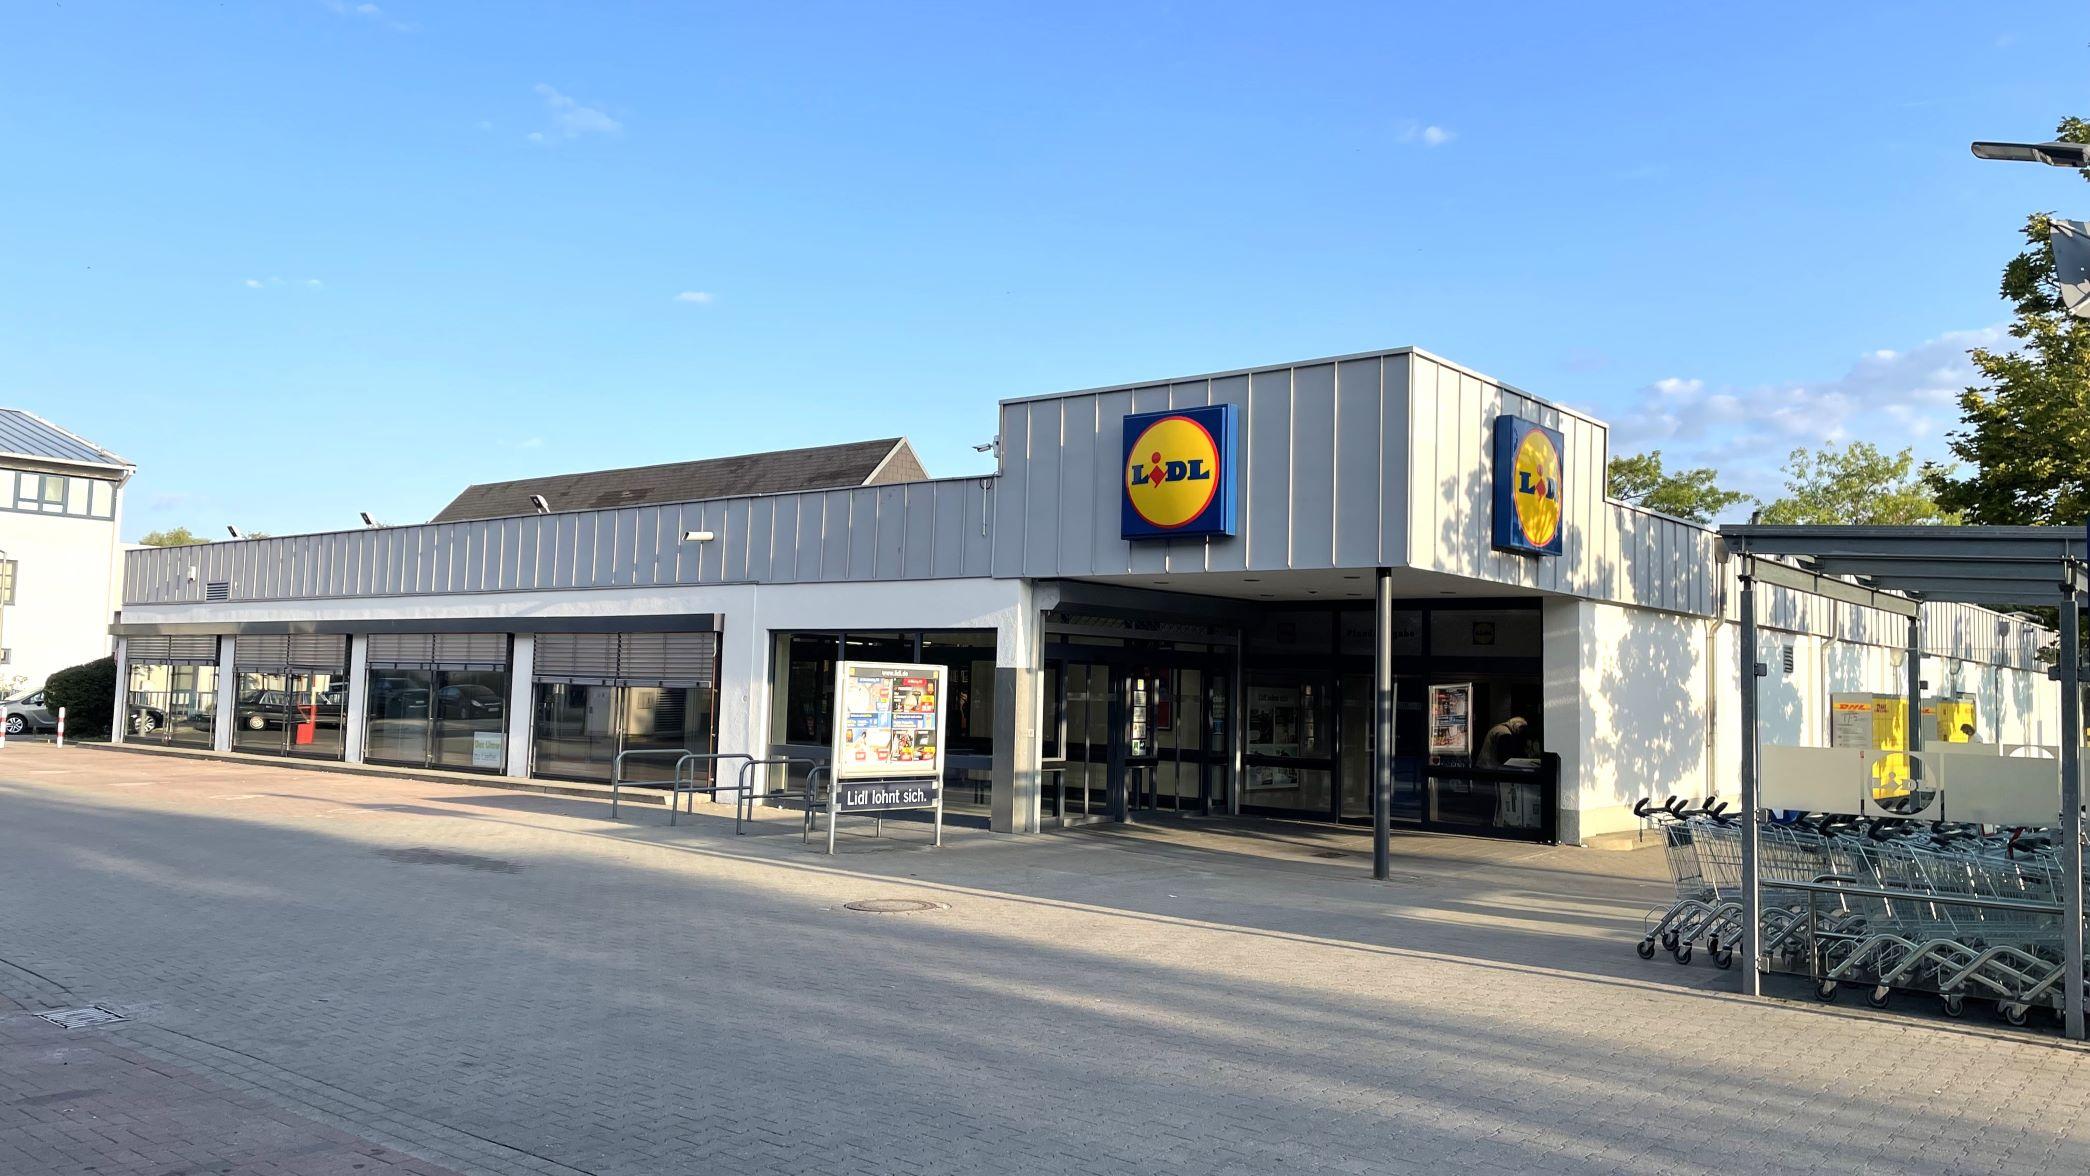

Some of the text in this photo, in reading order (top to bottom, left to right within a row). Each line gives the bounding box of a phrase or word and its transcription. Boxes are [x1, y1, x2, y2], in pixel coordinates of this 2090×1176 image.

[1131, 451, 1210, 489] LIDL
[847, 788, 927, 806] Lidl lohnt sich.
